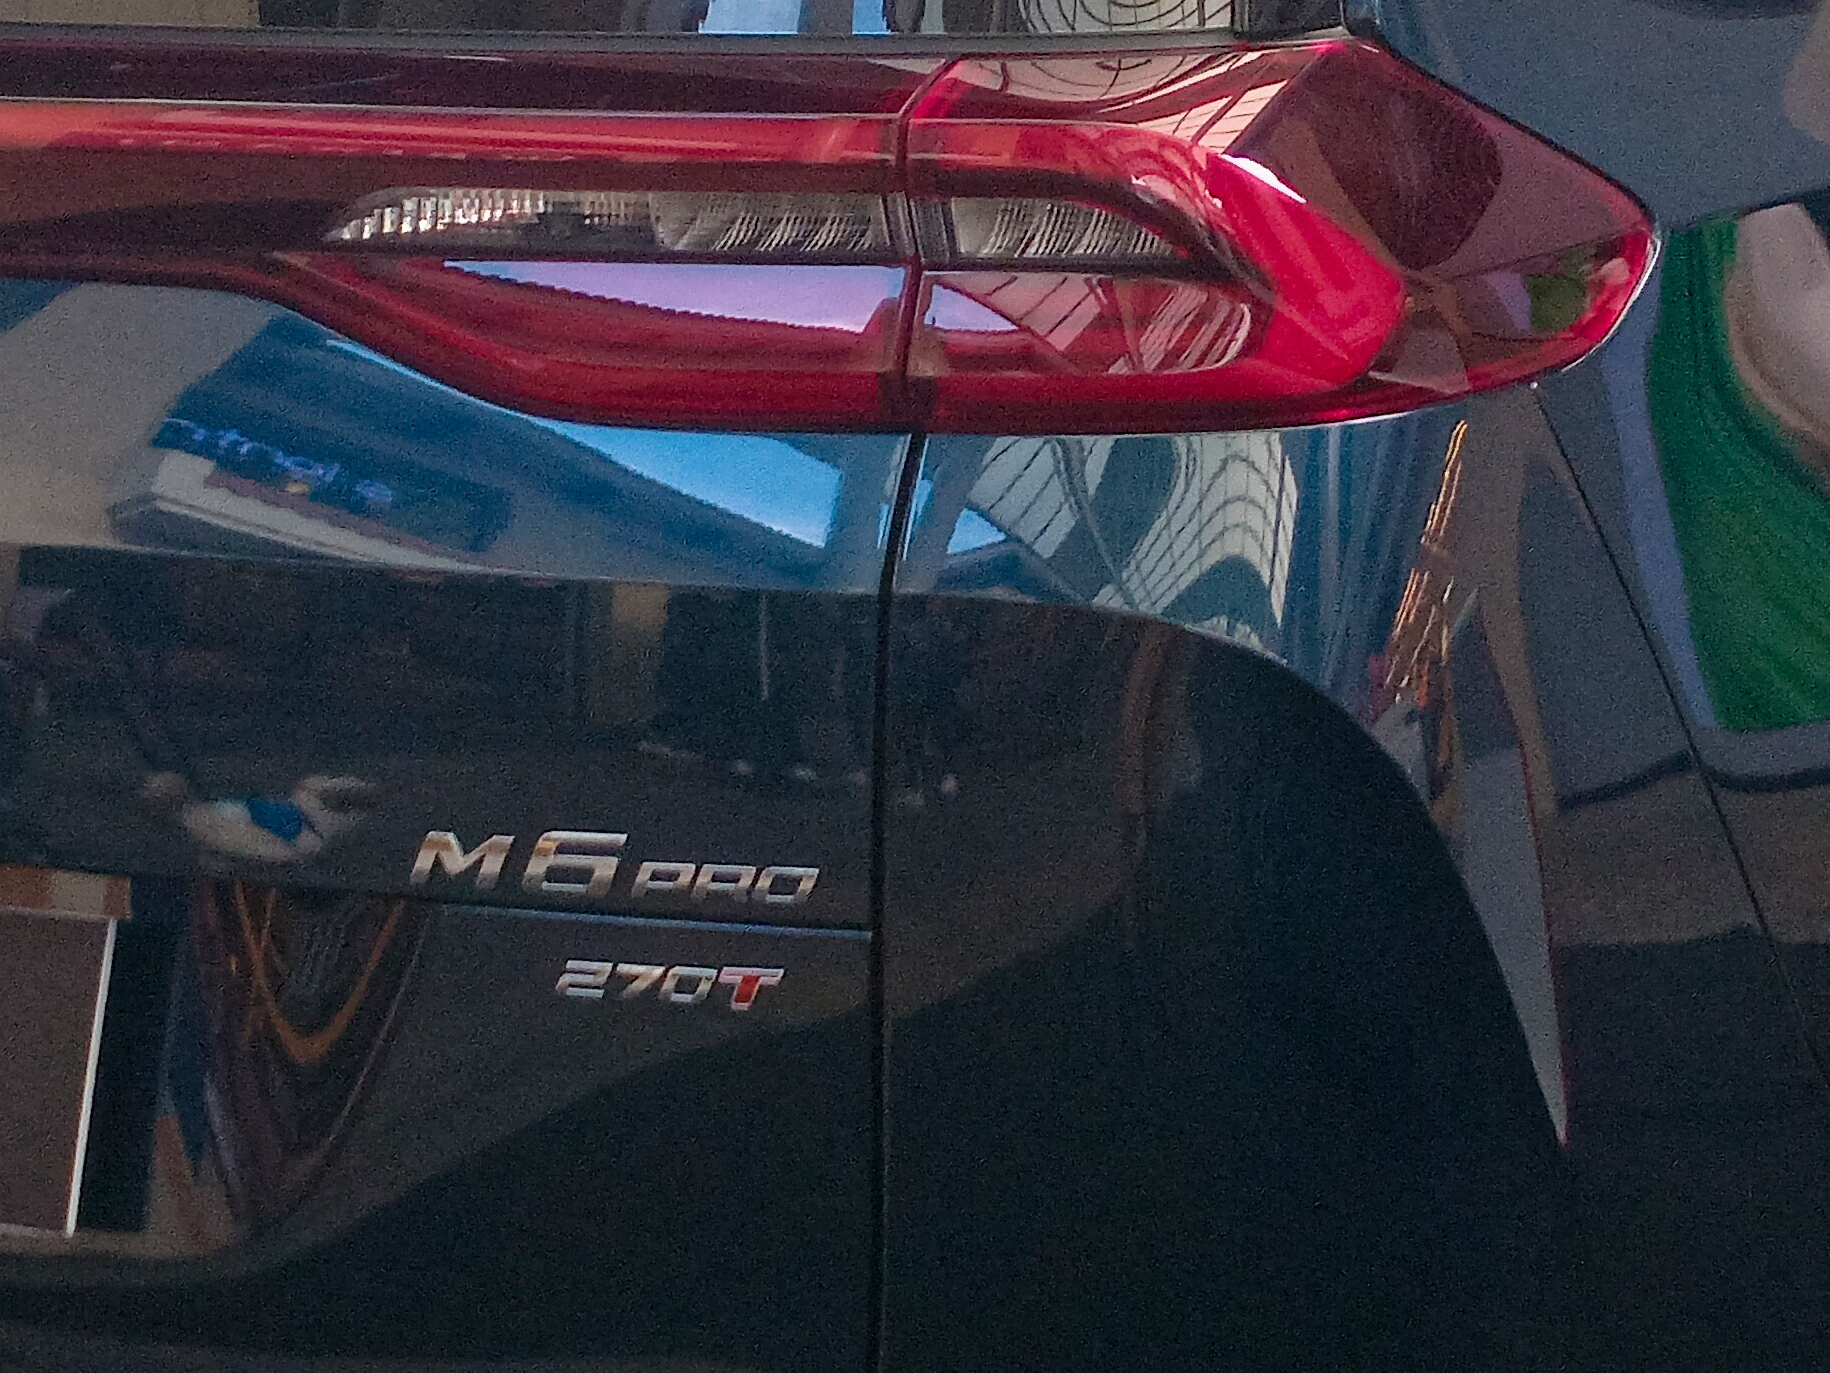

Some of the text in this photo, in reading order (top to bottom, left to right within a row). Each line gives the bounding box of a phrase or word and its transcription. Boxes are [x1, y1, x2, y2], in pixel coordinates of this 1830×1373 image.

[408, 829, 820, 904] M6 PRO
[555, 958, 785, 1012] 270T
